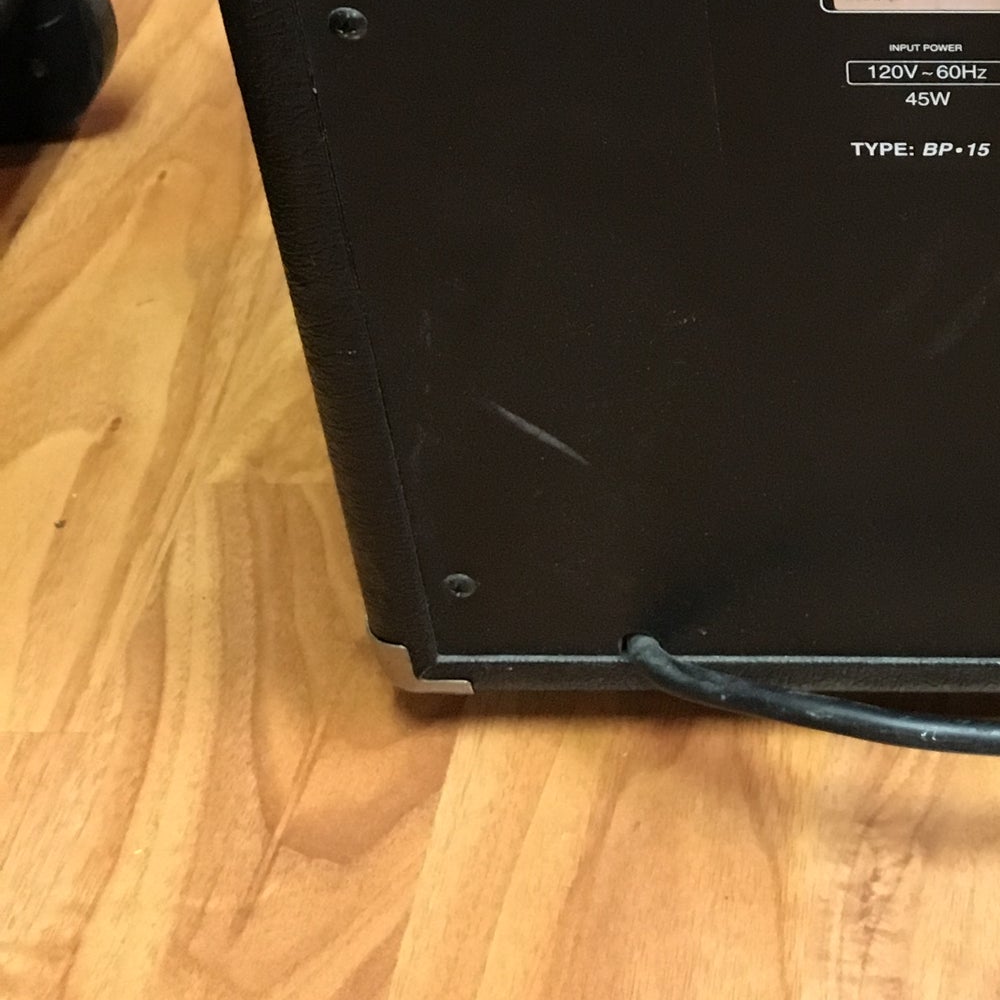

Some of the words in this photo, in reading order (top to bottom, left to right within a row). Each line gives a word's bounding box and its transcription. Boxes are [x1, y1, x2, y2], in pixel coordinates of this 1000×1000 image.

[888, 43, 921, 53] INPUT
[922, 43, 963, 53] POWER
[904, 91, 951, 107] 45W
[850, 141, 915, 157] TYPE:
